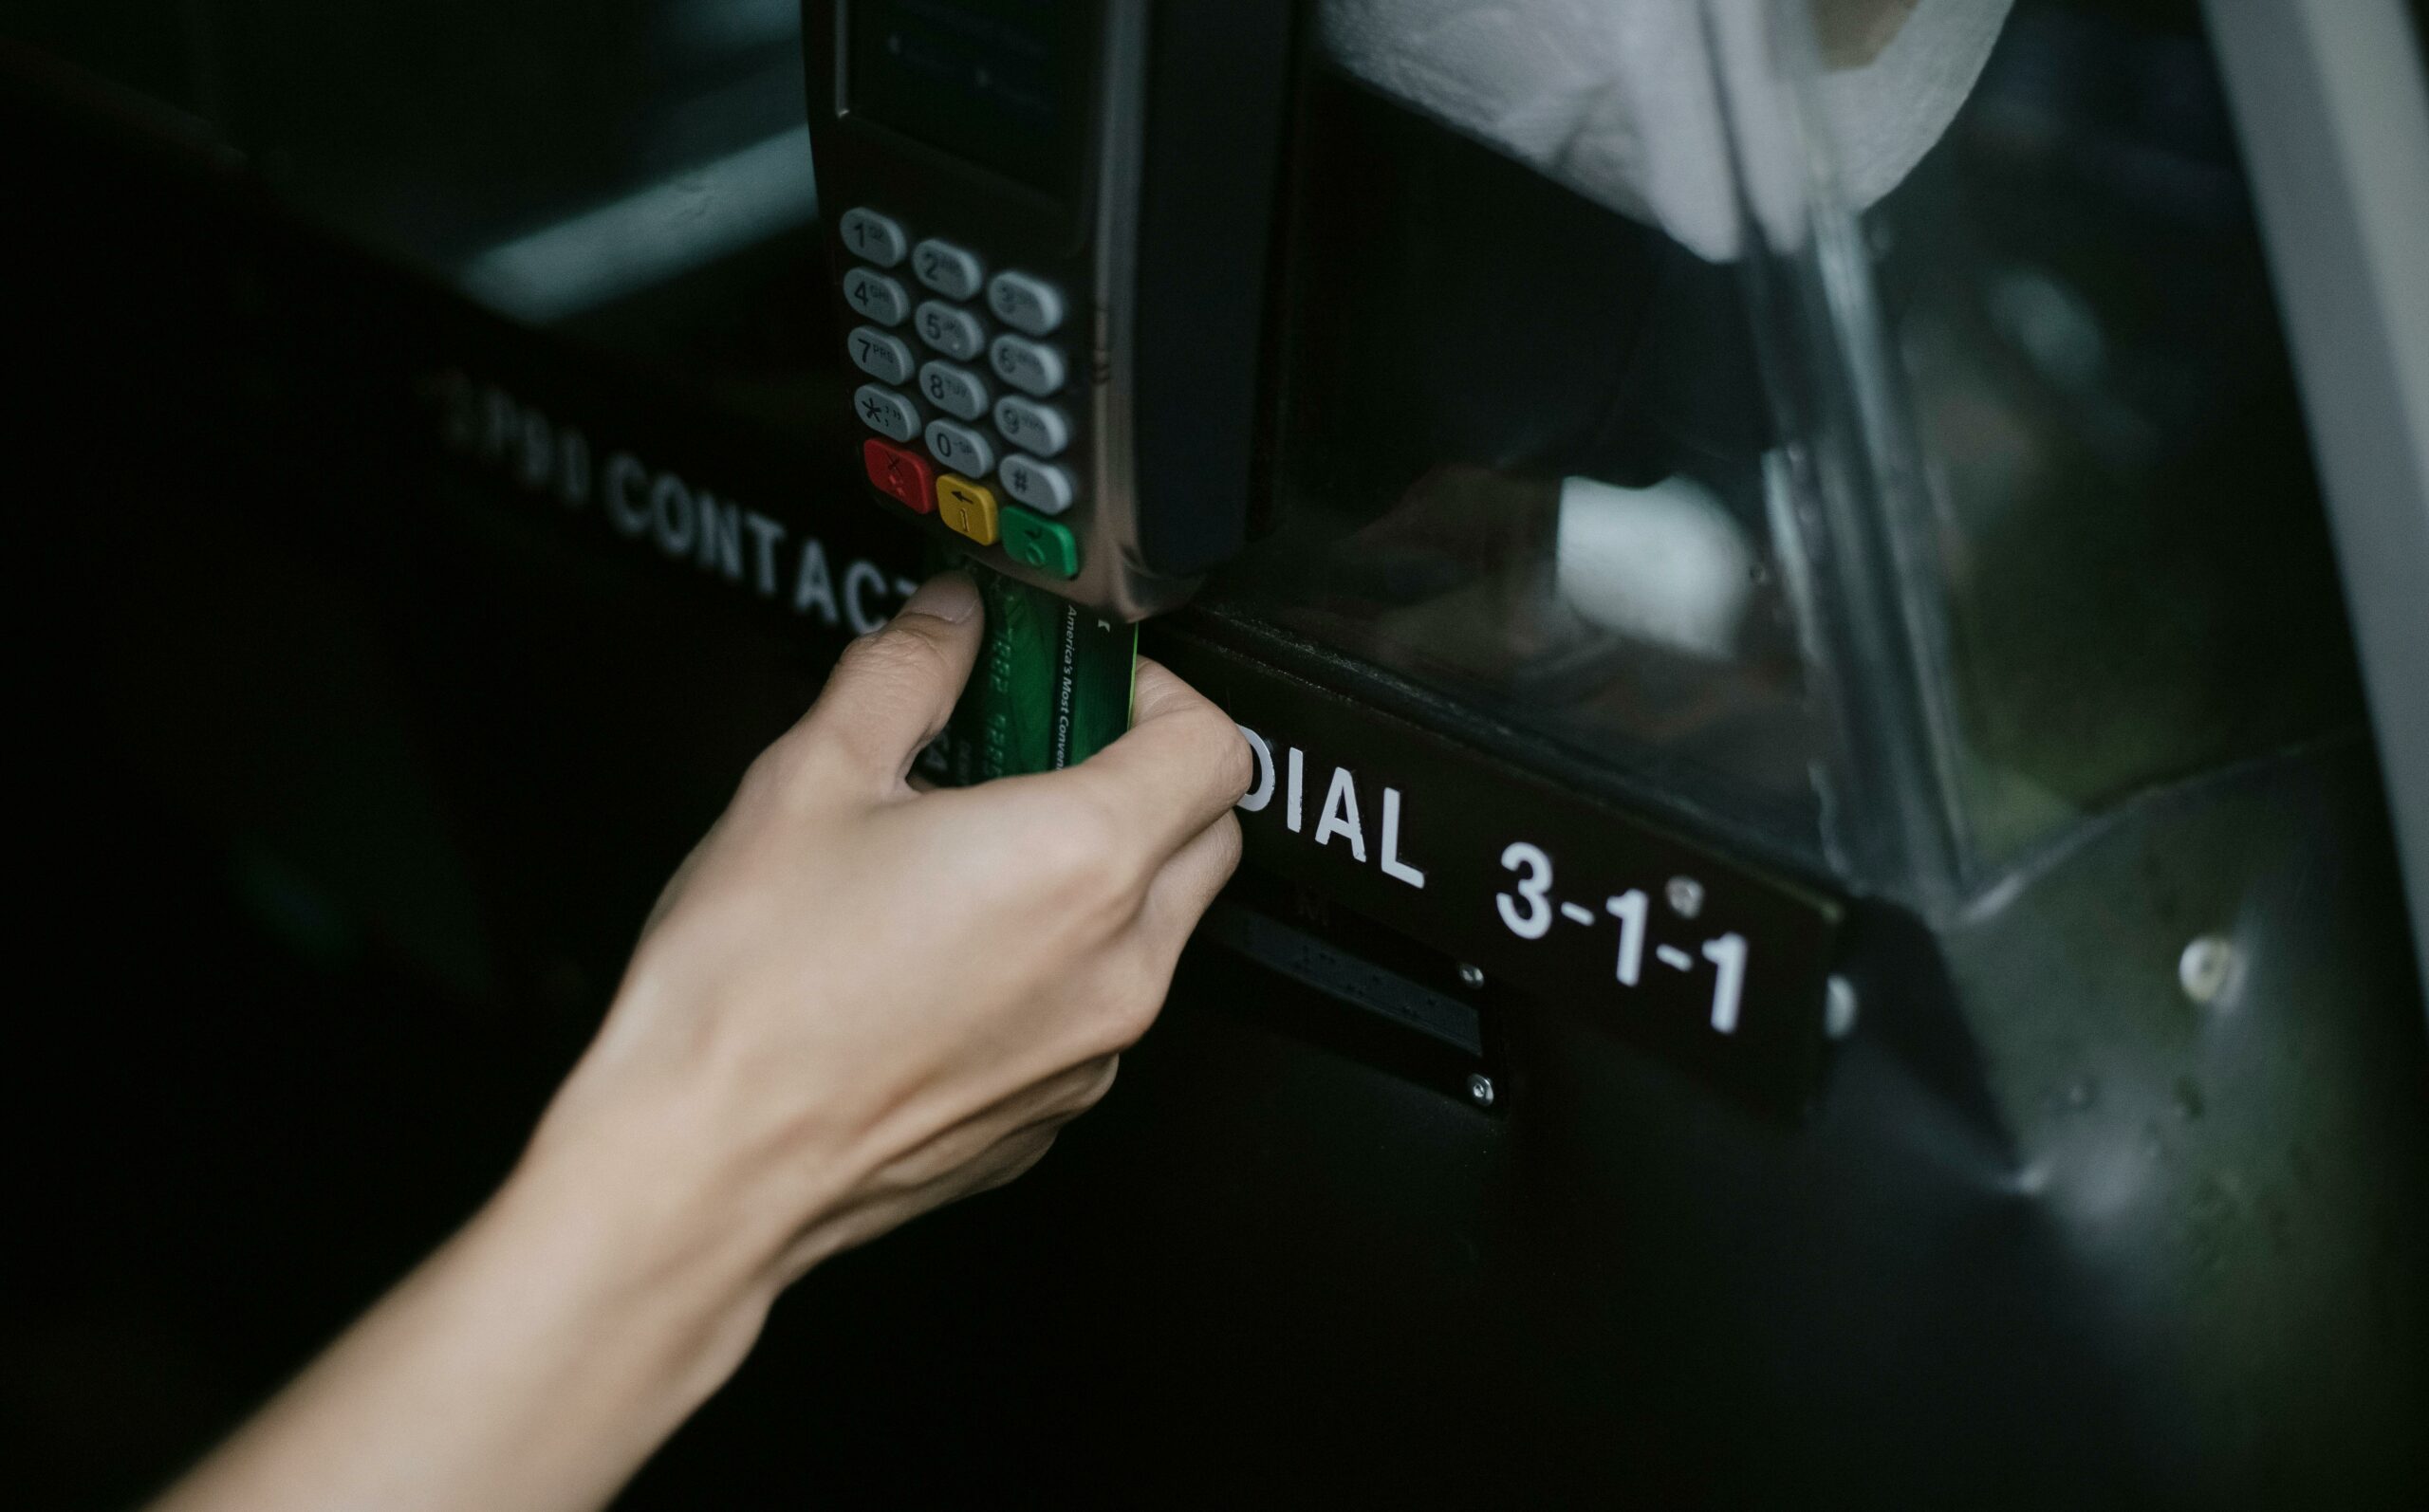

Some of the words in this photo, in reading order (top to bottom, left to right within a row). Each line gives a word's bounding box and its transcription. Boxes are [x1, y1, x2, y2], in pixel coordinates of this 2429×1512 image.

[853, 222, 864, 249] 1
[924, 251, 938, 281] 2
[854, 282, 869, 306] 4
[926, 313, 941, 340] 5
[857, 338, 872, 363] 7
[930, 373, 945, 399] 8
[1003, 409, 1019, 434] 9
[936, 432, 952, 458] 0
[1062, 604, 1078, 675] America's
[1059, 675, 1073, 713] Most
[601, 448, 920, 636] CONTAC
[1236, 723, 1425, 889] DIAL
[1495, 840, 1750, 1036] 3-1-1
[1055, 714, 1070, 771] Conven
